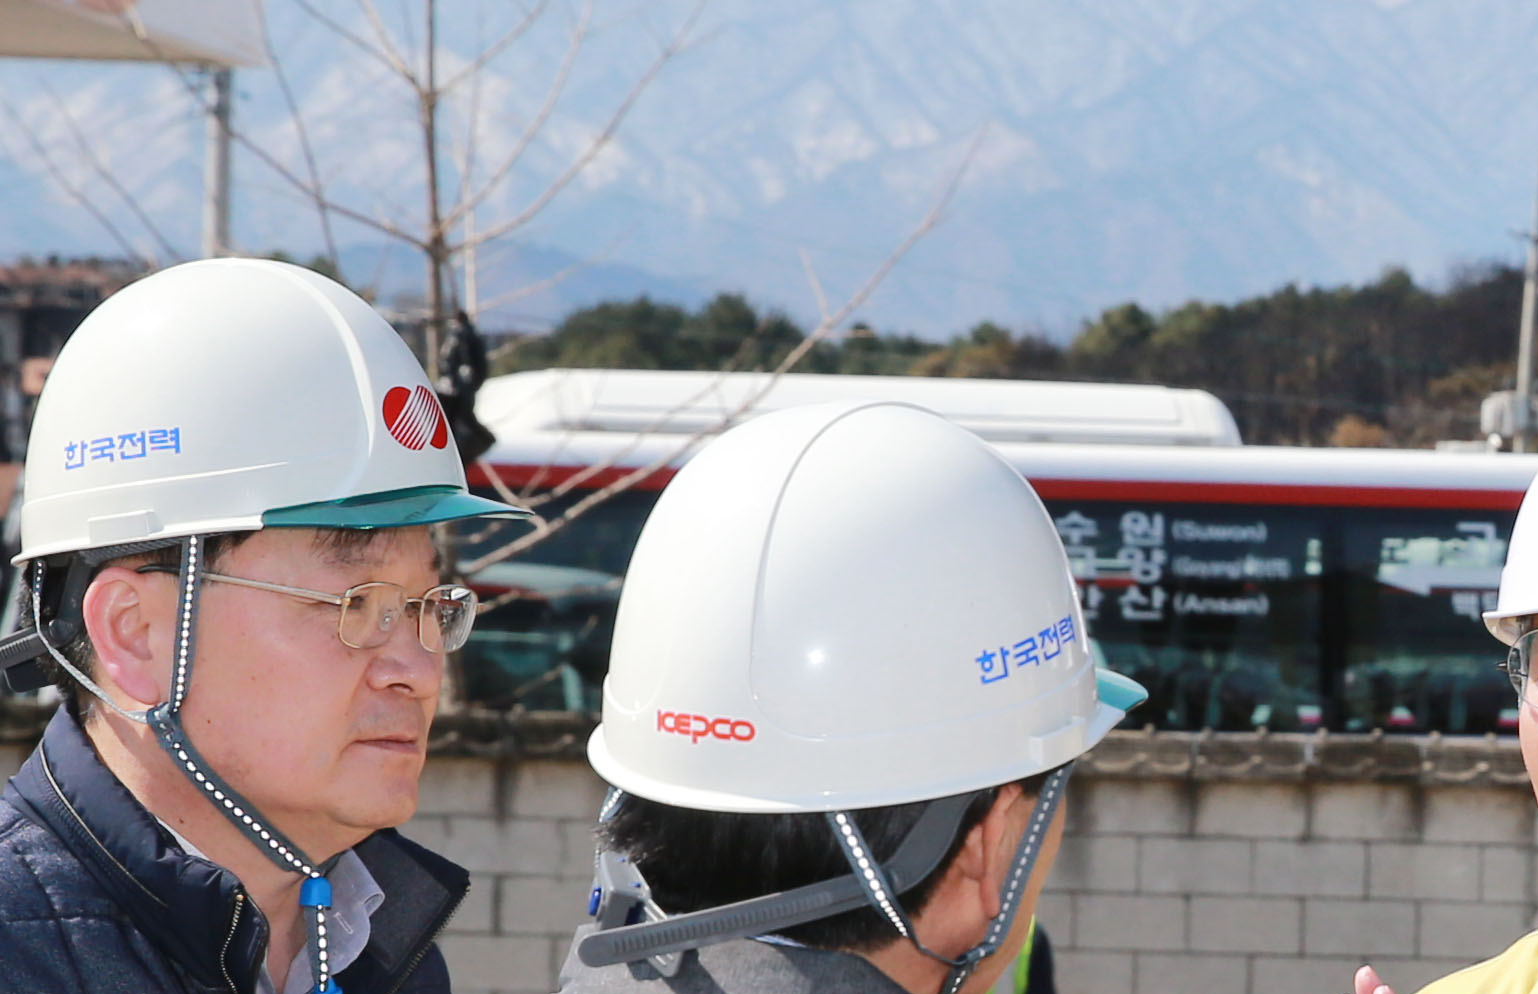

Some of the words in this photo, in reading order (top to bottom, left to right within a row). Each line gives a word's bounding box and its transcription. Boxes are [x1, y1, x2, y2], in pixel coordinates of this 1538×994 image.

[64, 427, 181, 470] 한국전력
[975, 614, 1076, 685] 한국전력
[657, 708, 756, 744] KEPCO
